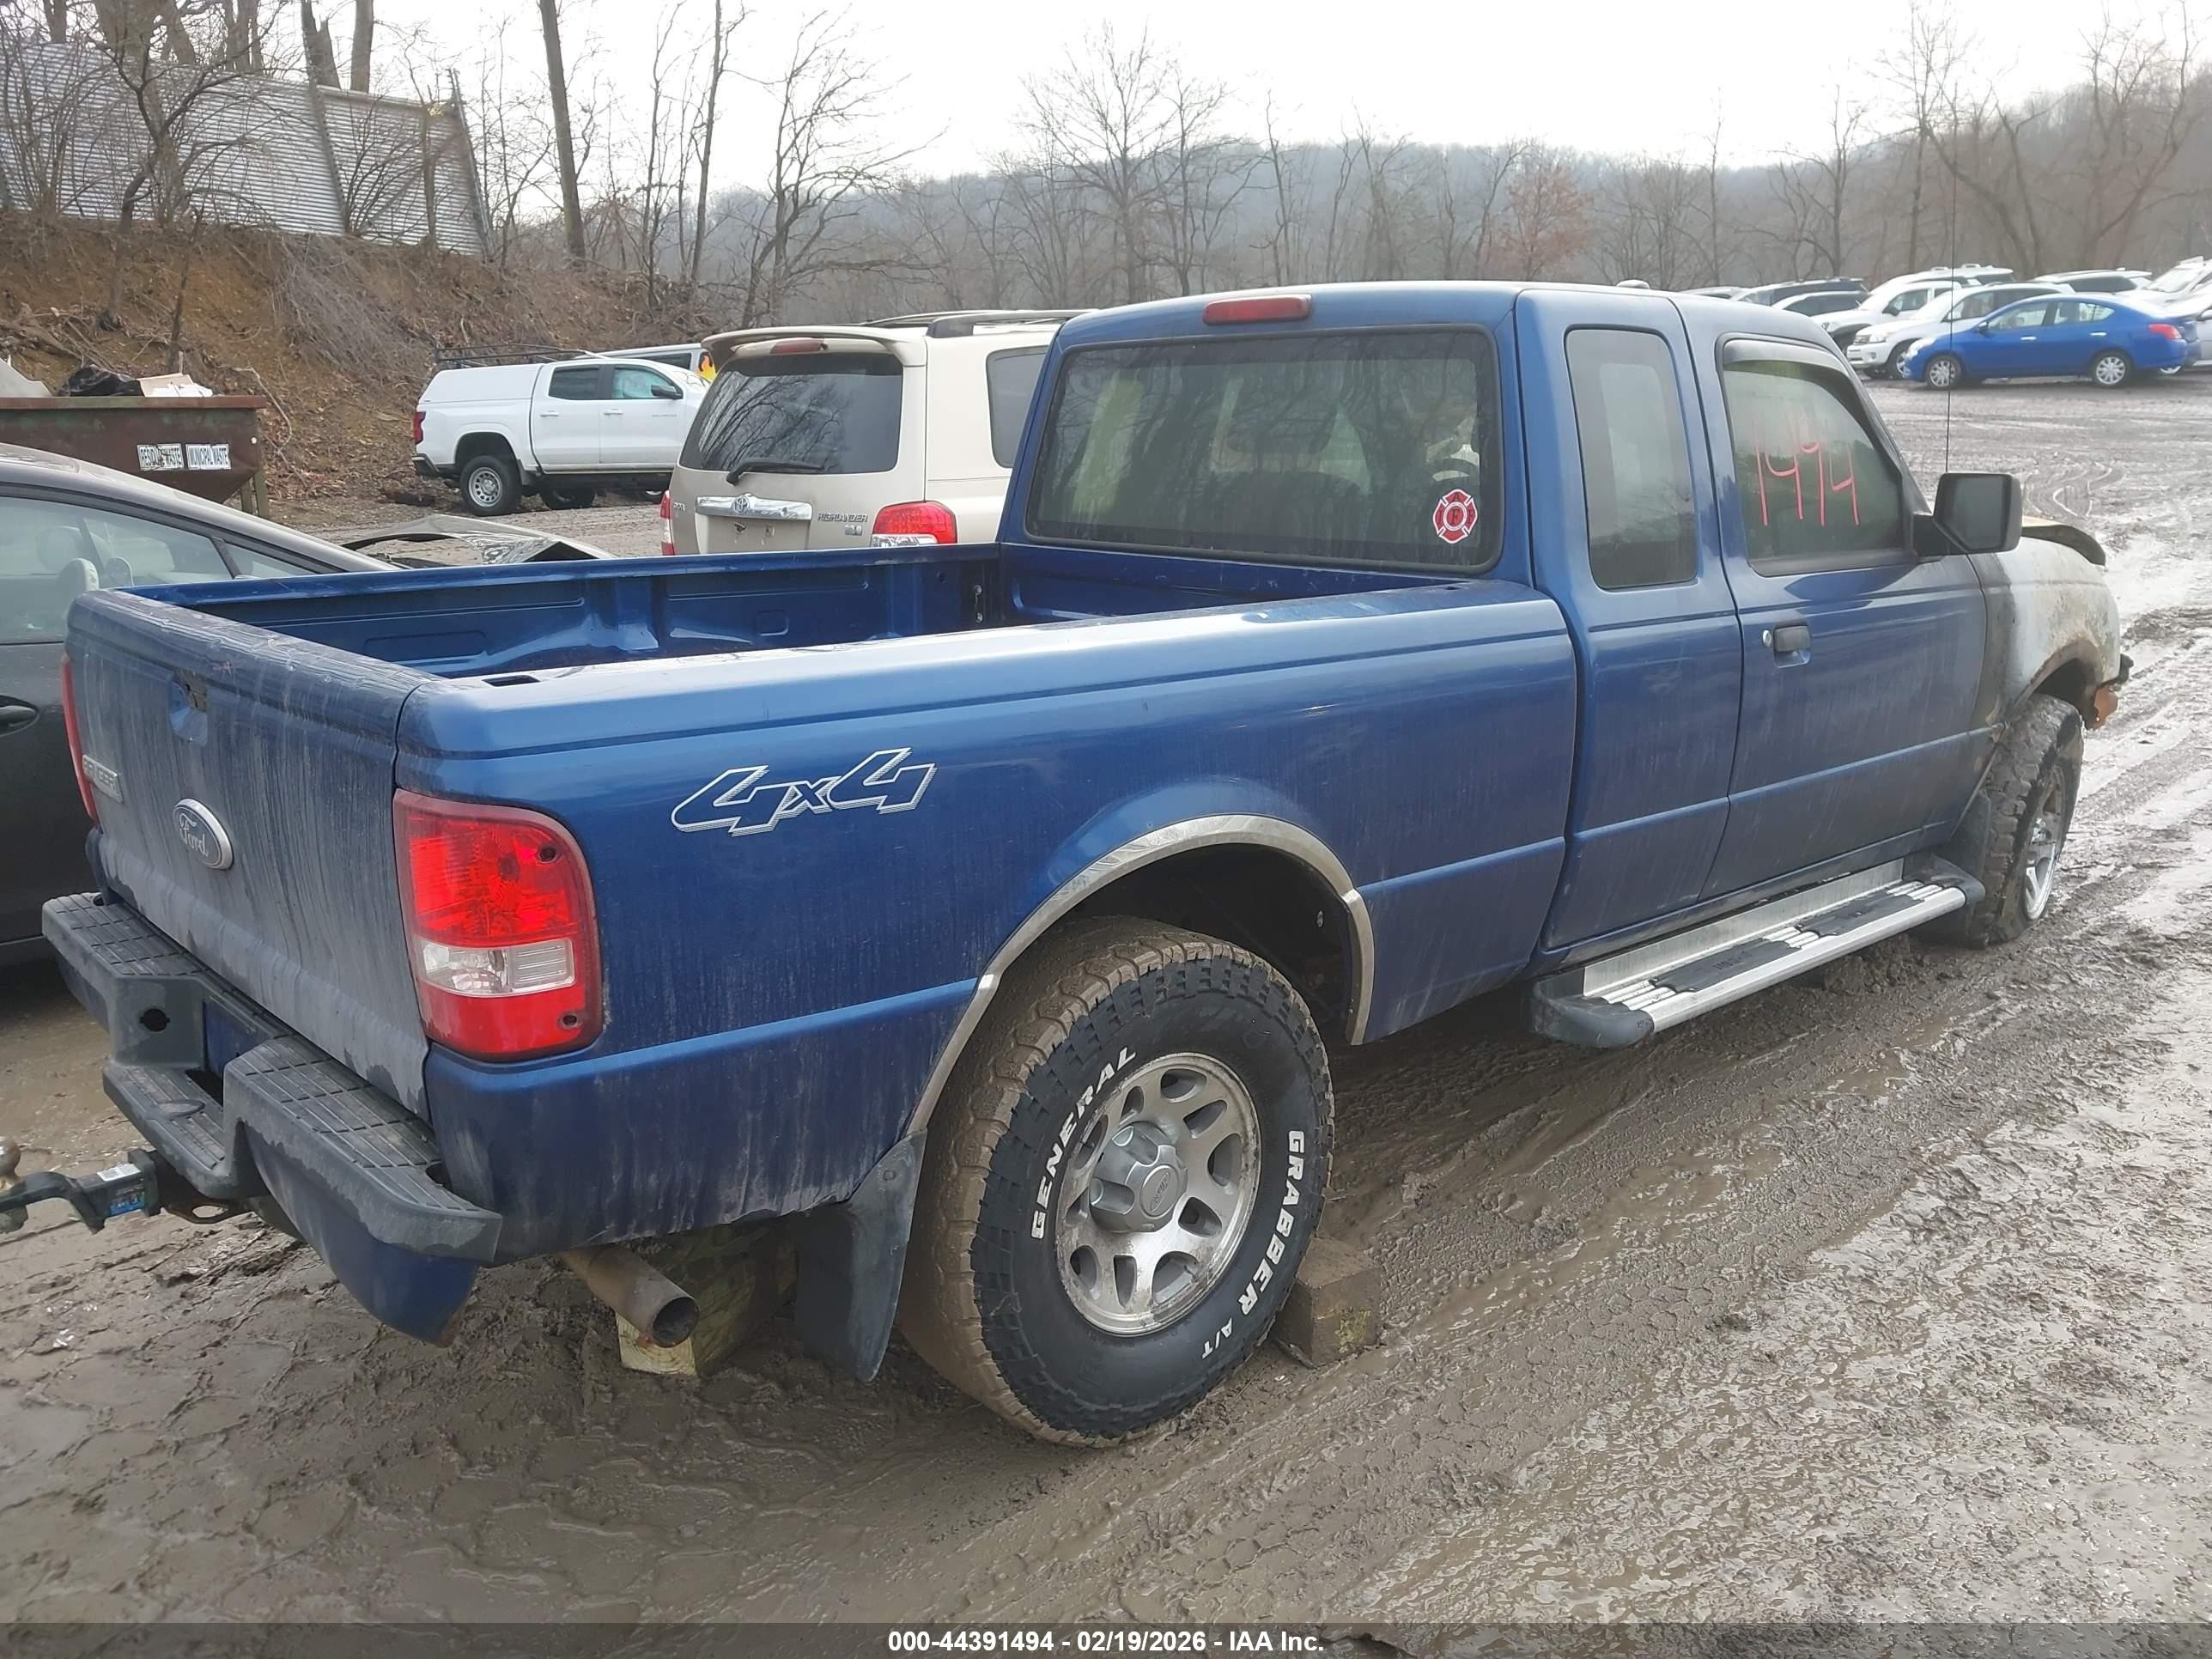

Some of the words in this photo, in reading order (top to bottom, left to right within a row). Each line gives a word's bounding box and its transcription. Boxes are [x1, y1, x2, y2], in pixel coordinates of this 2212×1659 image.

[188, 447, 215, 465] MUNICIPAL
[212, 447, 229, 465] WASTE
[817, 514, 867, 522] HIGHLANDER
[671, 755, 938, 837] 4x4
[179, 812, 208, 857] Ford
[1031, 1047, 1136, 1239] GENERAL
[1237, 1130, 1305, 1315] GRABBER
[1202, 1318, 1234, 1358] A/T
